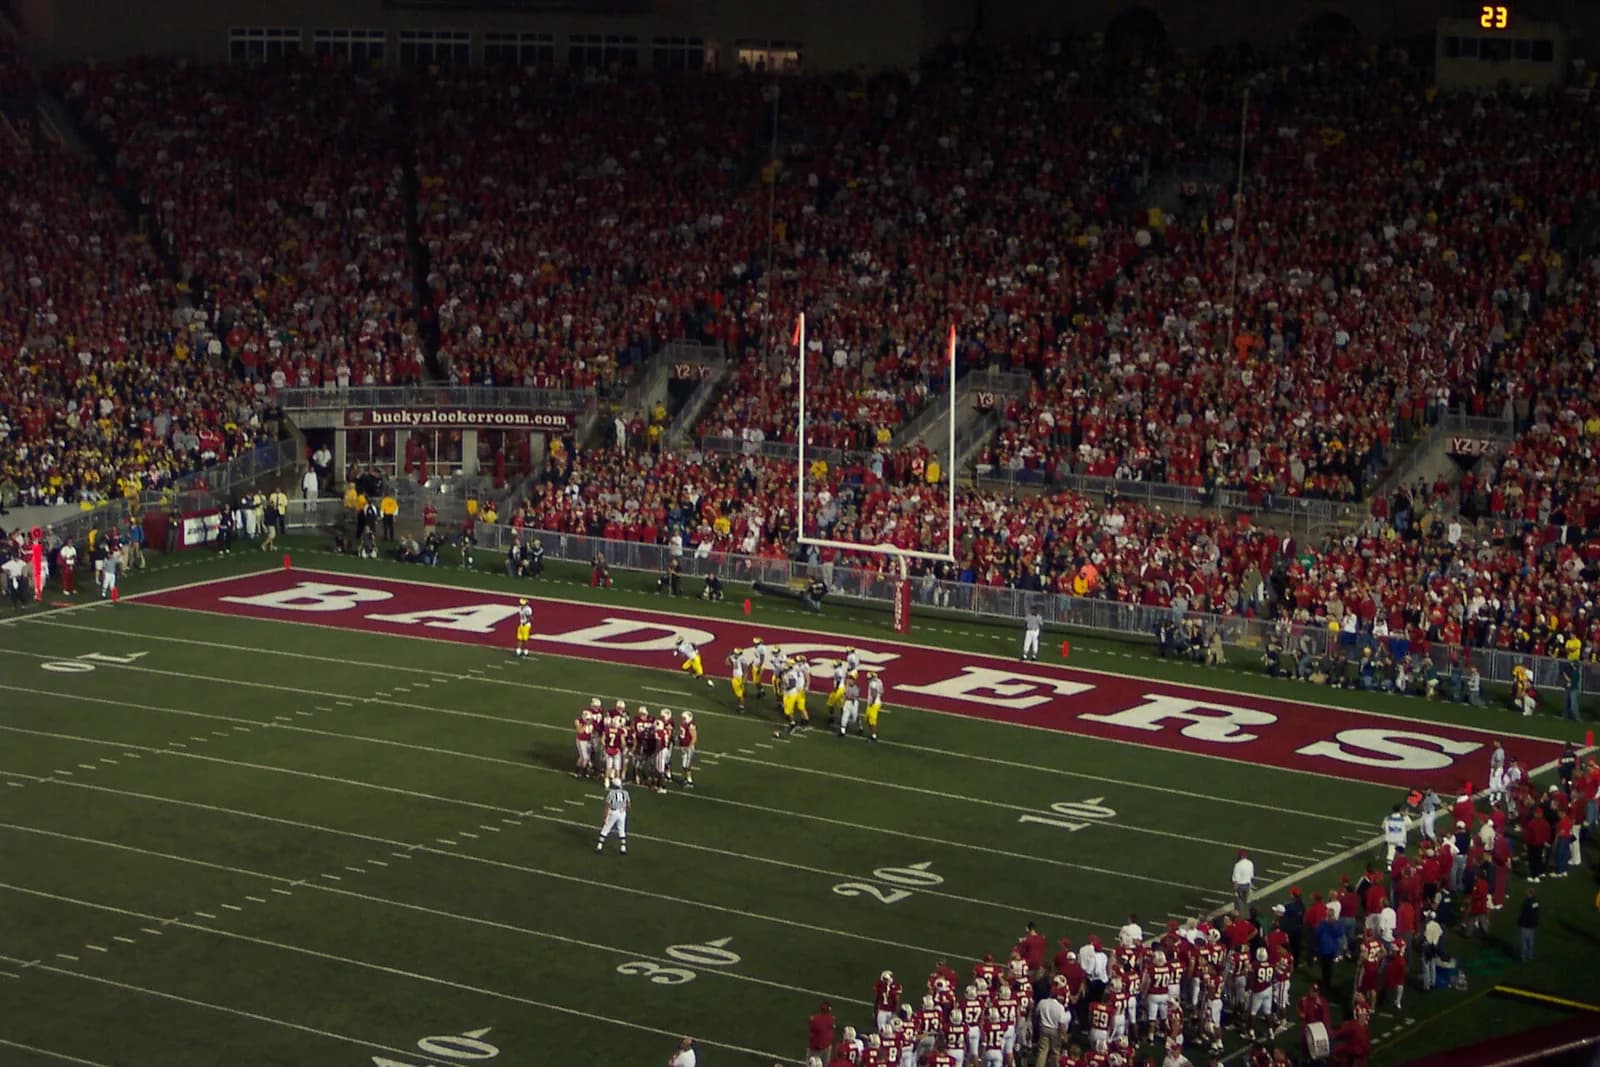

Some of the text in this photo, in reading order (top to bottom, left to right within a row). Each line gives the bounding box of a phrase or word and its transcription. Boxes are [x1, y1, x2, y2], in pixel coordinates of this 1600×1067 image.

[1481, 6, 1508, 28] 23
[372, 411, 566, 425] buckyslockerroom.com
[218, 581, 1485, 770] BADGERS
[1018, 797, 1117, 832] 10
[832, 861, 945, 904] 20
[616, 937, 741, 985] 30
[1257, 967, 1274, 983] 98
[964, 1007, 981, 1023] 57
[1000, 1006, 1016, 1022] 34
